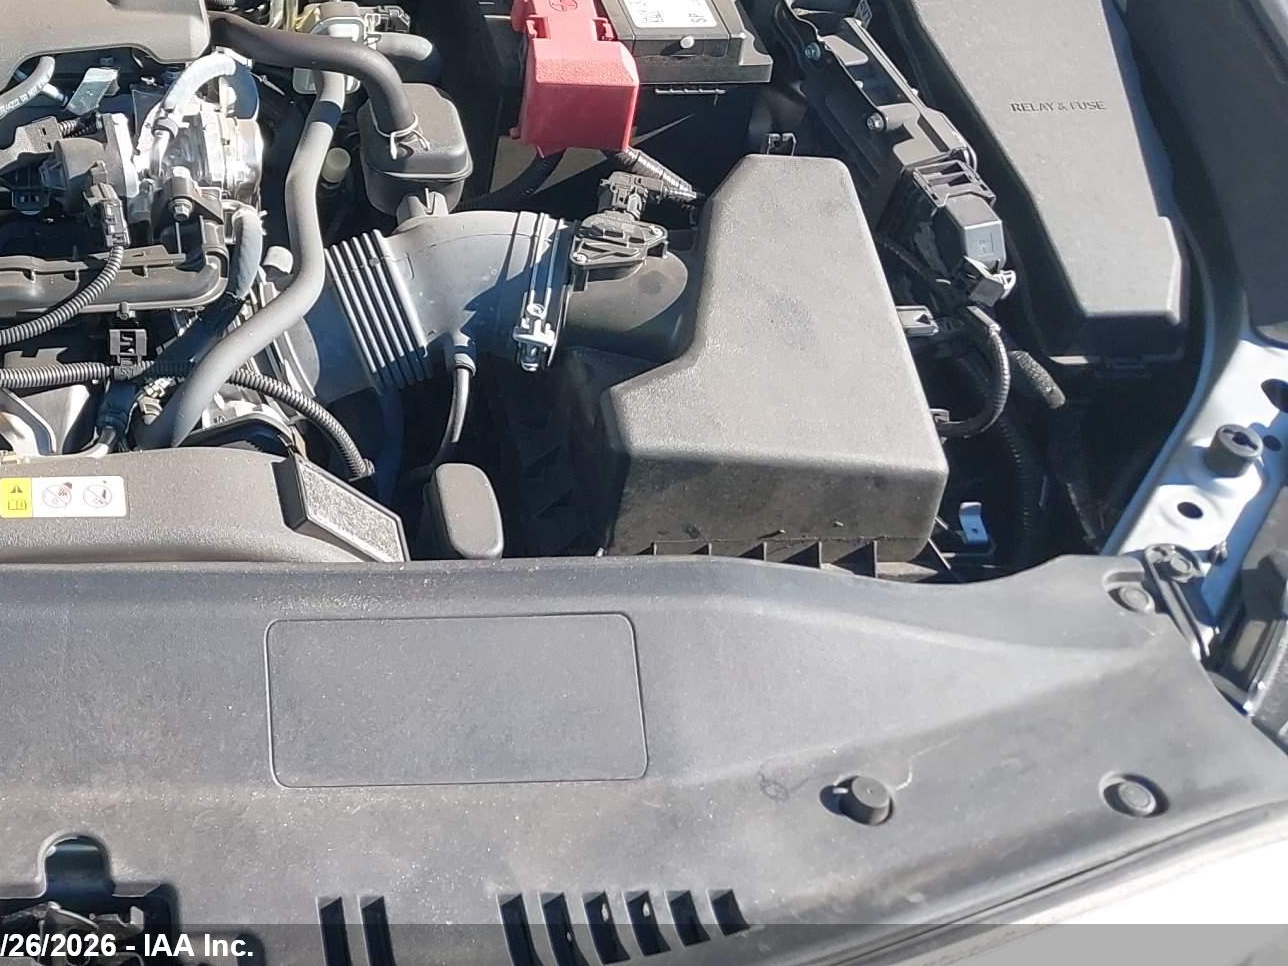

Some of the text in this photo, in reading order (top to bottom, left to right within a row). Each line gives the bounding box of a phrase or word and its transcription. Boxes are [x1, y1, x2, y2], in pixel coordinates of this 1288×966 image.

[1010, 100, 1105, 112] RELAY & FUSE
